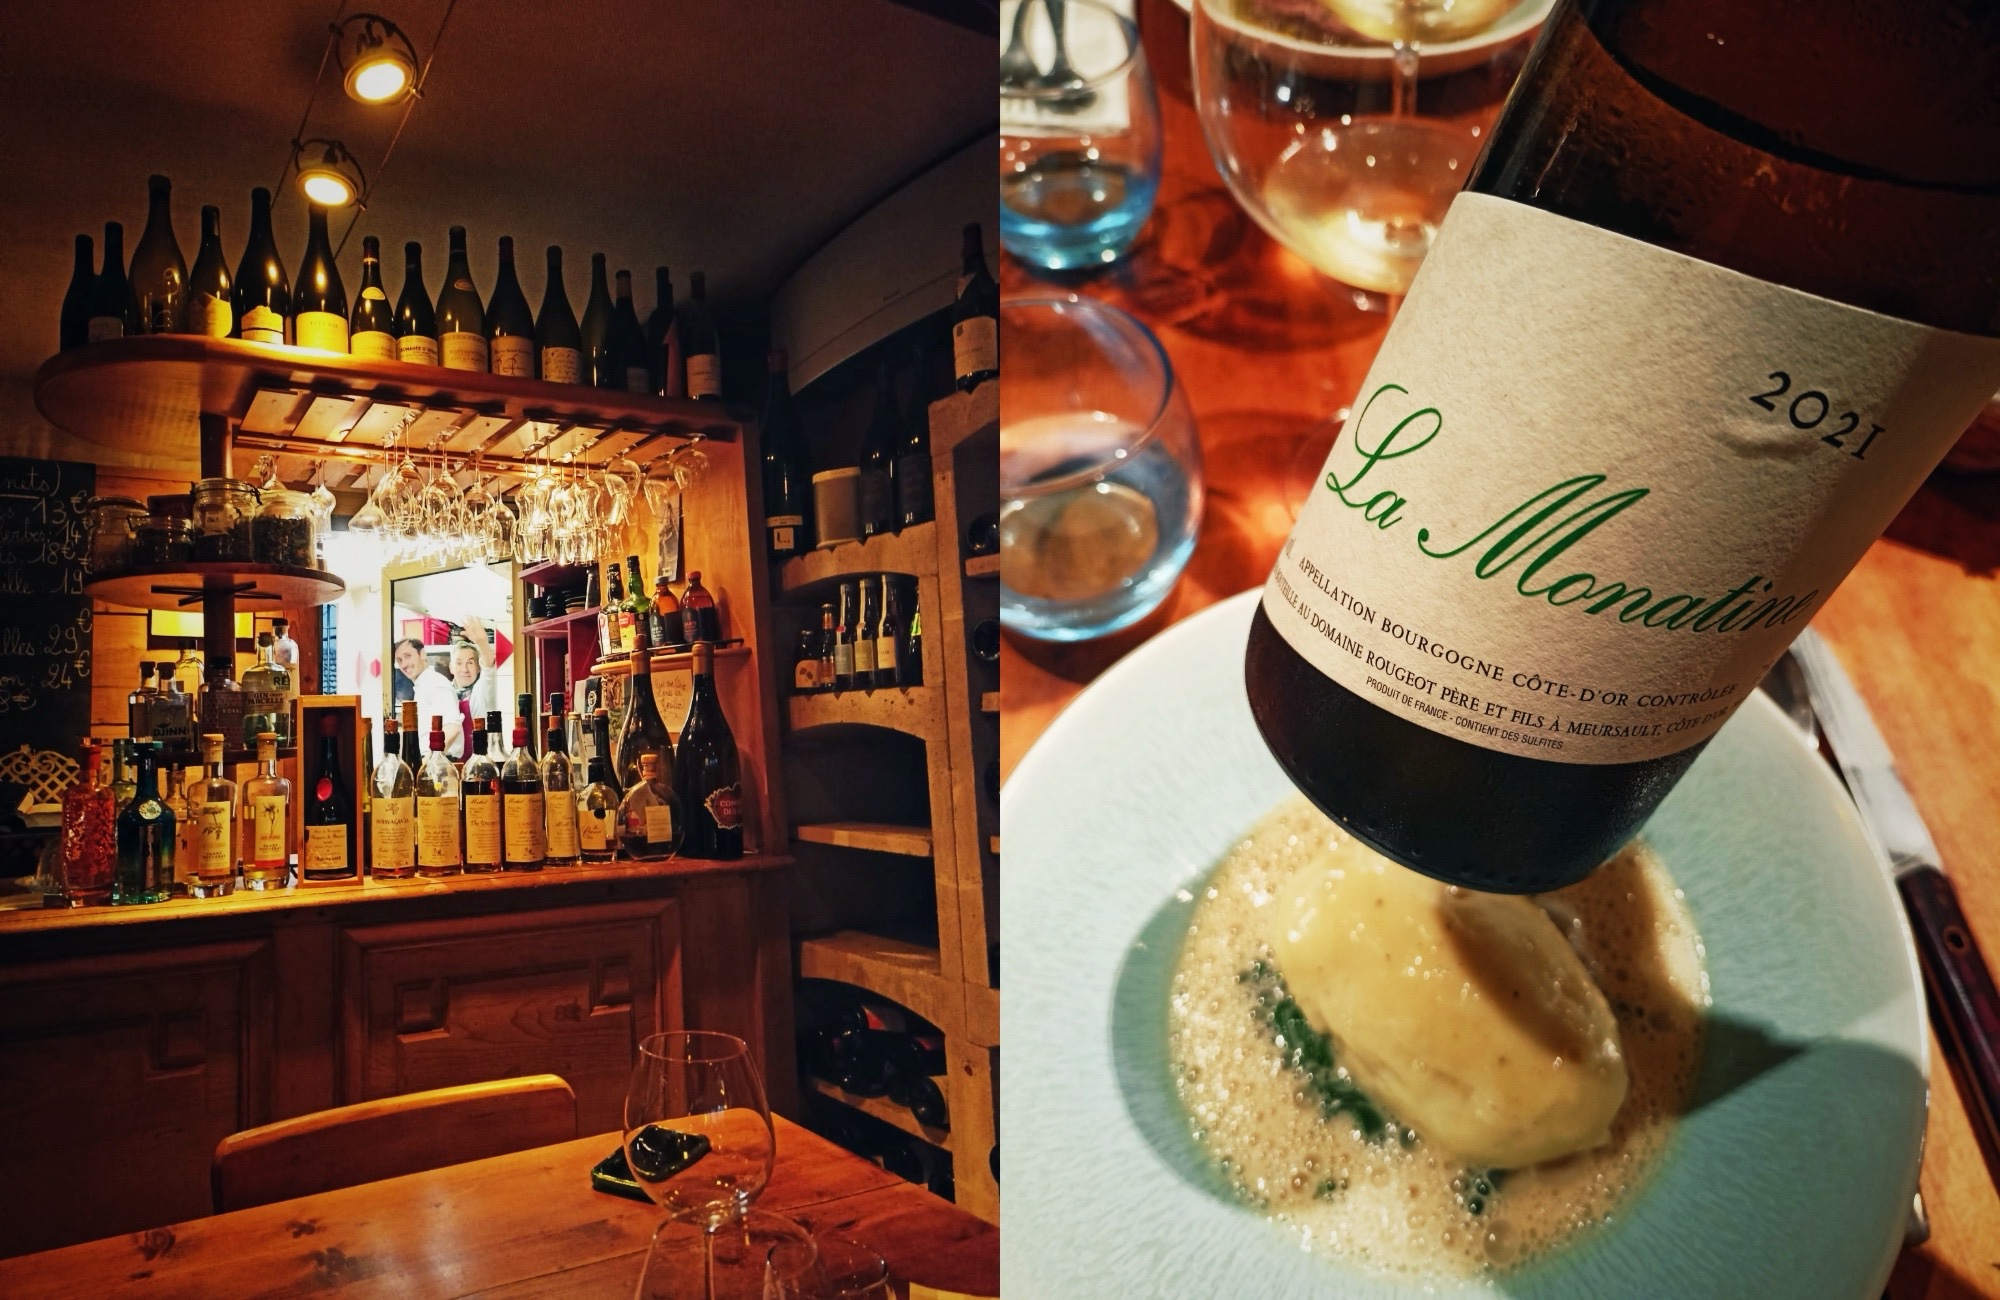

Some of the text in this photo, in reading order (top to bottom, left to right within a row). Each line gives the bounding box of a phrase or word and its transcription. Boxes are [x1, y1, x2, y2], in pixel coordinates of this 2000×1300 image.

[1749, 371, 1886, 461] 2021
[1326, 384, 1819, 634] La Monatine
[1297, 601, 1311, 620] AU
[1311, 612, 1364, 659] DOMAINE
[1365, 650, 1437, 695] ROUGEOT
[1440, 686, 1480, 712] PÈRE
[1484, 701, 1507, 719] ET
[1511, 709, 1545, 729] FILS
[1549, 715, 1560, 732] À
[1567, 720, 1662, 738] MEURSAULT,
[1666, 718, 1700, 734] CÔTE
[1299, 556, 1377, 624] APPELLATION
[1381, 617, 1504, 682] BOURGOGNE
[1512, 673, 1629, 707] CÔTE-D'OR
[1366, 676, 1401, 701] PRODUIT
[1401, 694, 1413, 707] DE
[1414, 699, 1448, 720] FRANCE
[1455, 715, 1500, 737] CONTIENT
[1501, 729, 1520, 742] DES
[1521, 734, 1564, 750] SULFITES
